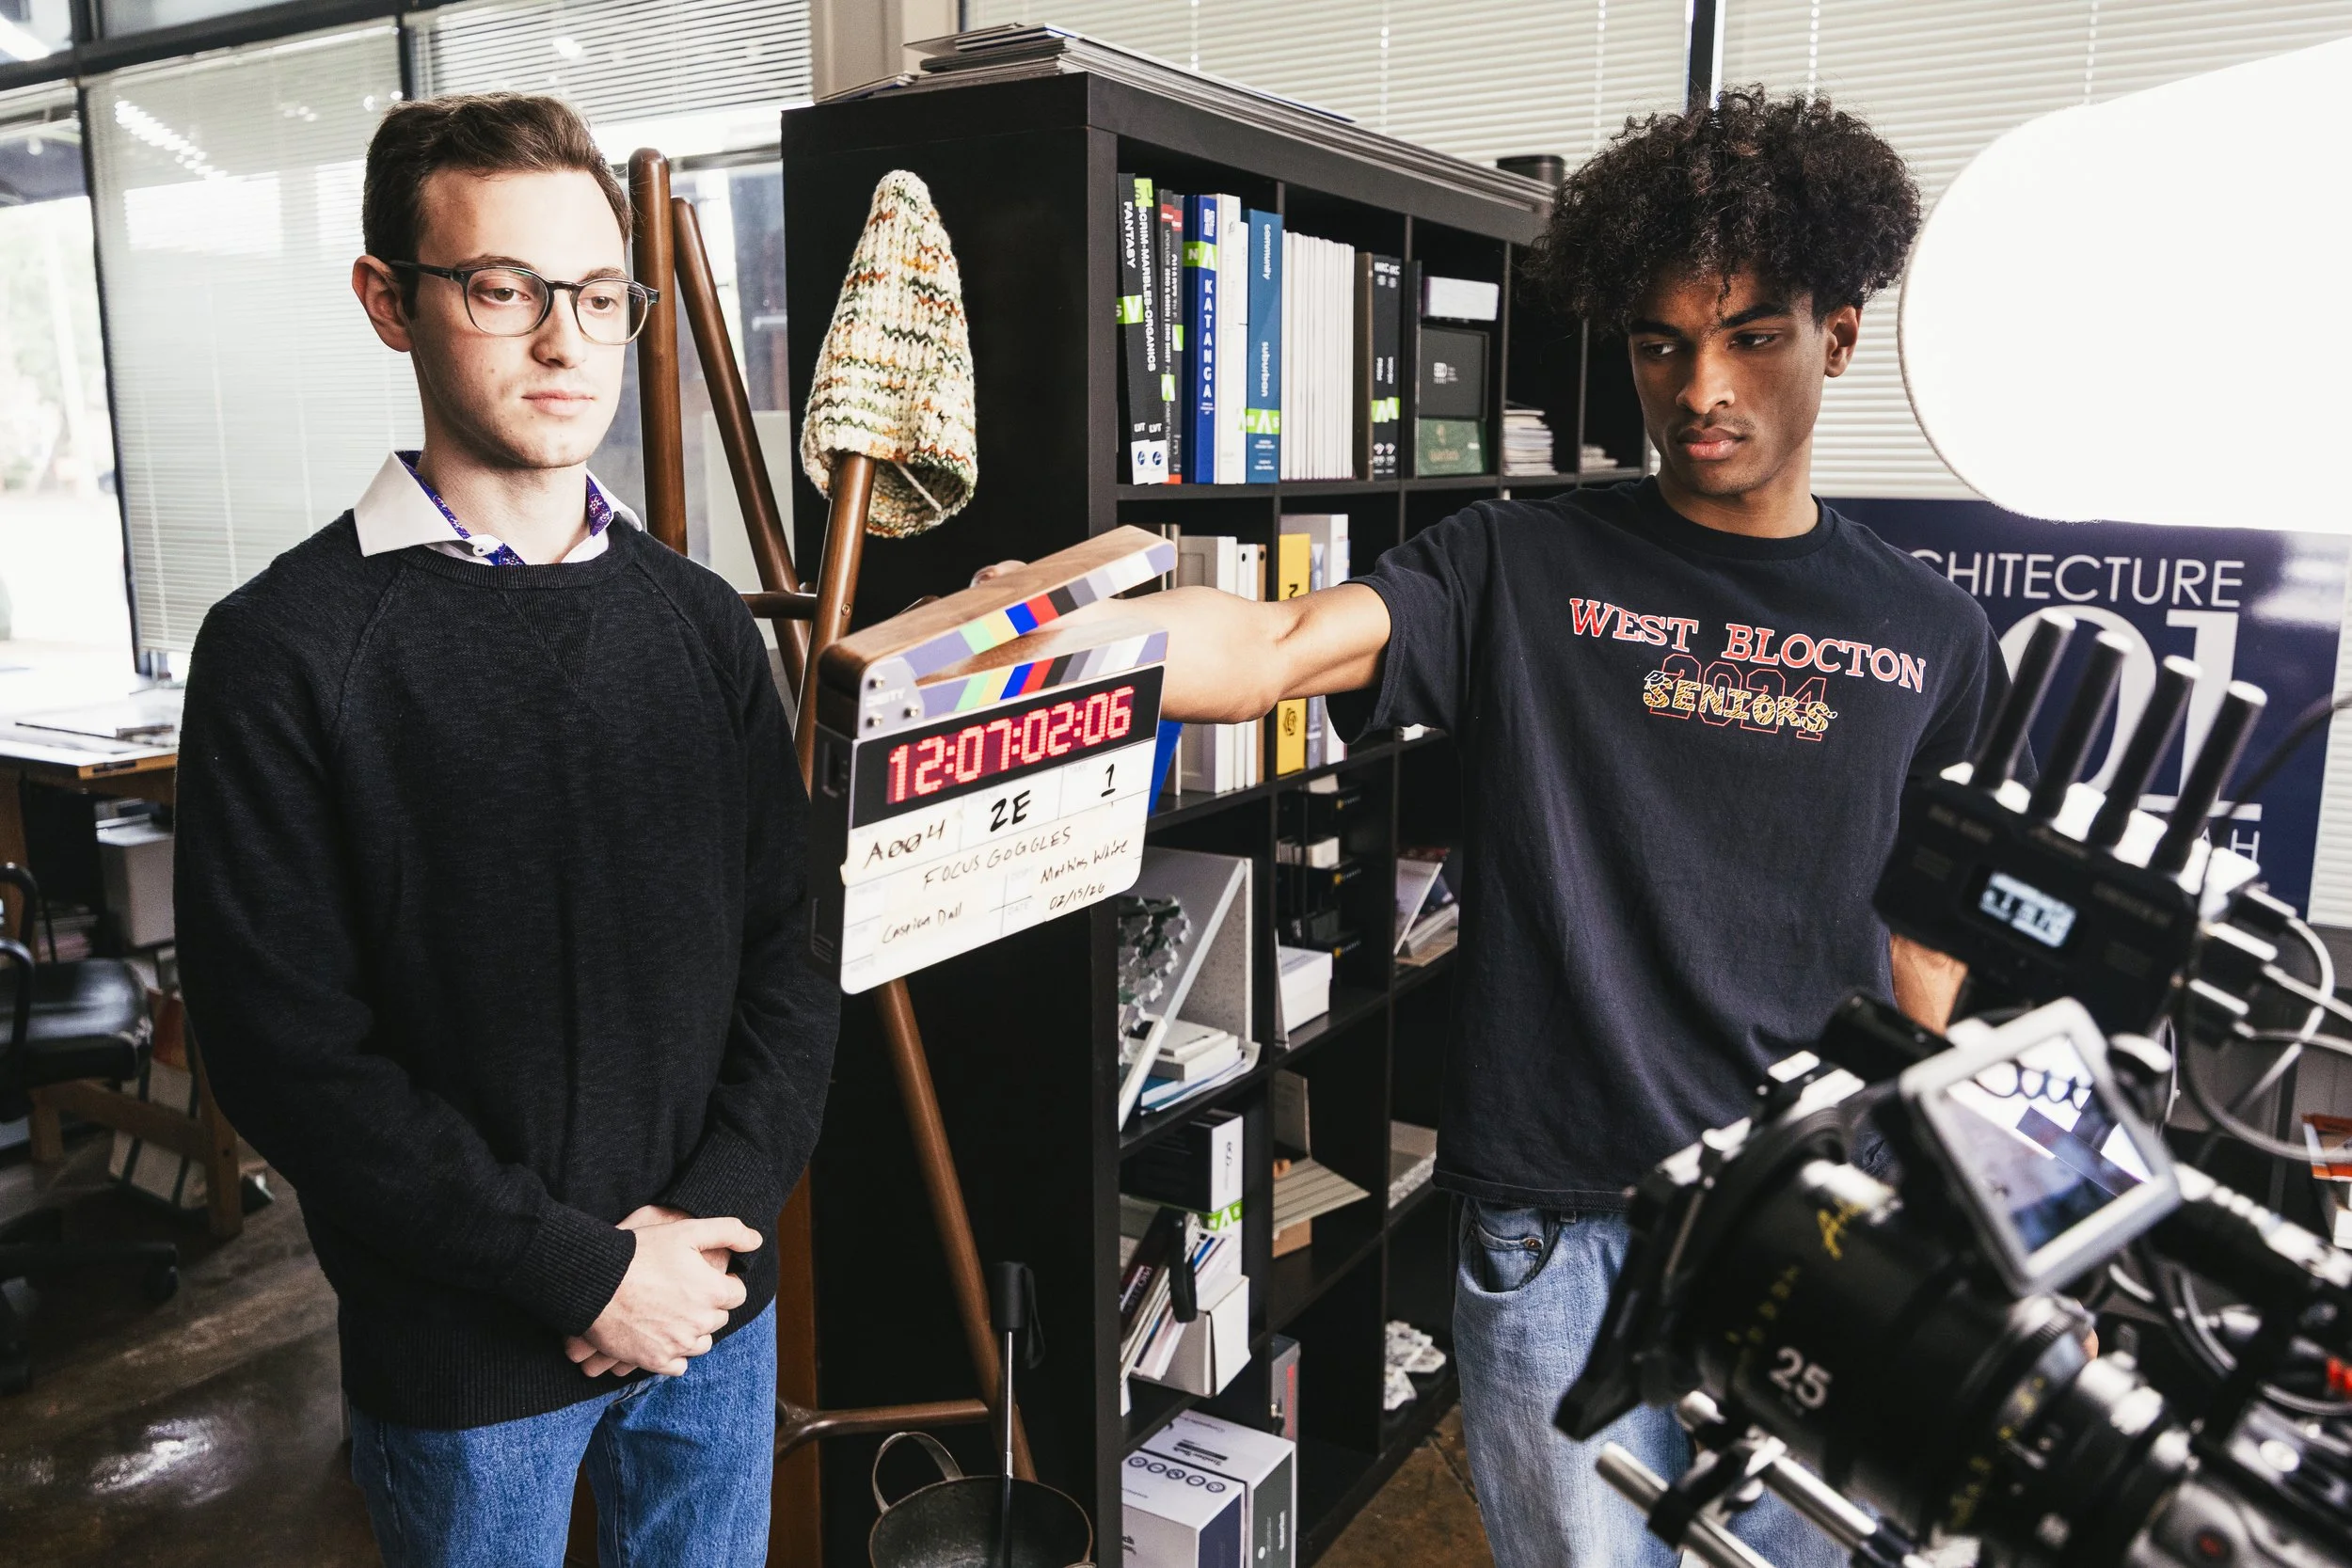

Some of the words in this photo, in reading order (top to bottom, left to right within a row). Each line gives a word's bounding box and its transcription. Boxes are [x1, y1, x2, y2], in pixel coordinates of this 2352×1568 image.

[1123, 200, 1136, 269] FANTASY
[1202, 279, 1213, 398] KATANGA
[1261, 341, 1270, 397] suburban
[1569, 598, 1699, 652] WEST
[1721, 623, 1927, 693] BLOCTON
[1643, 675, 1838, 733] SENIORS
[1649, 653, 1827, 741] 2024
[888, 687, 1135, 803] 12:07:02:06
[990, 789, 1031, 832] 2E
[1101, 763, 1116, 798] 1
[923, 855, 980, 891] FOCUS
[987, 826, 1072, 869] GOGGLES
[1767, 1346, 1833, 1409] 25
